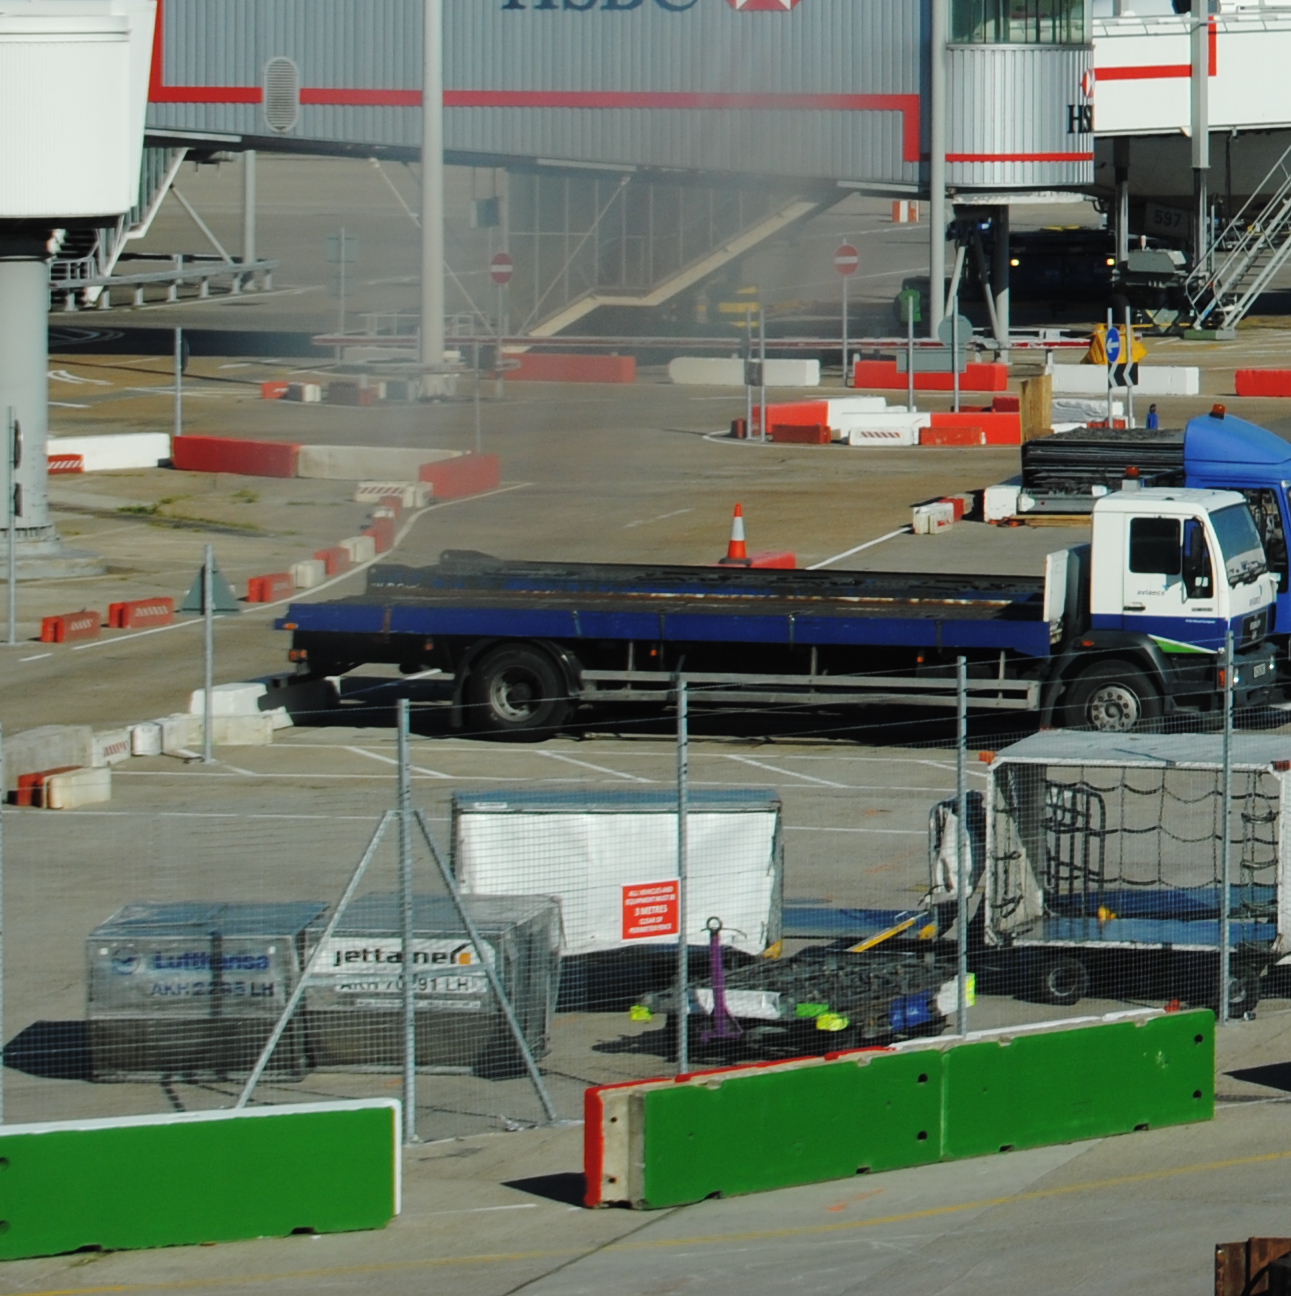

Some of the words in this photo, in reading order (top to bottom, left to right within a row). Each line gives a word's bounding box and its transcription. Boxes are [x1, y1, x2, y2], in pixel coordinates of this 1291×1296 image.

[1067, 104, 1094, 134] HS
[1154, 210, 1182, 228] 597
[333, 941, 473, 967] jettaner
